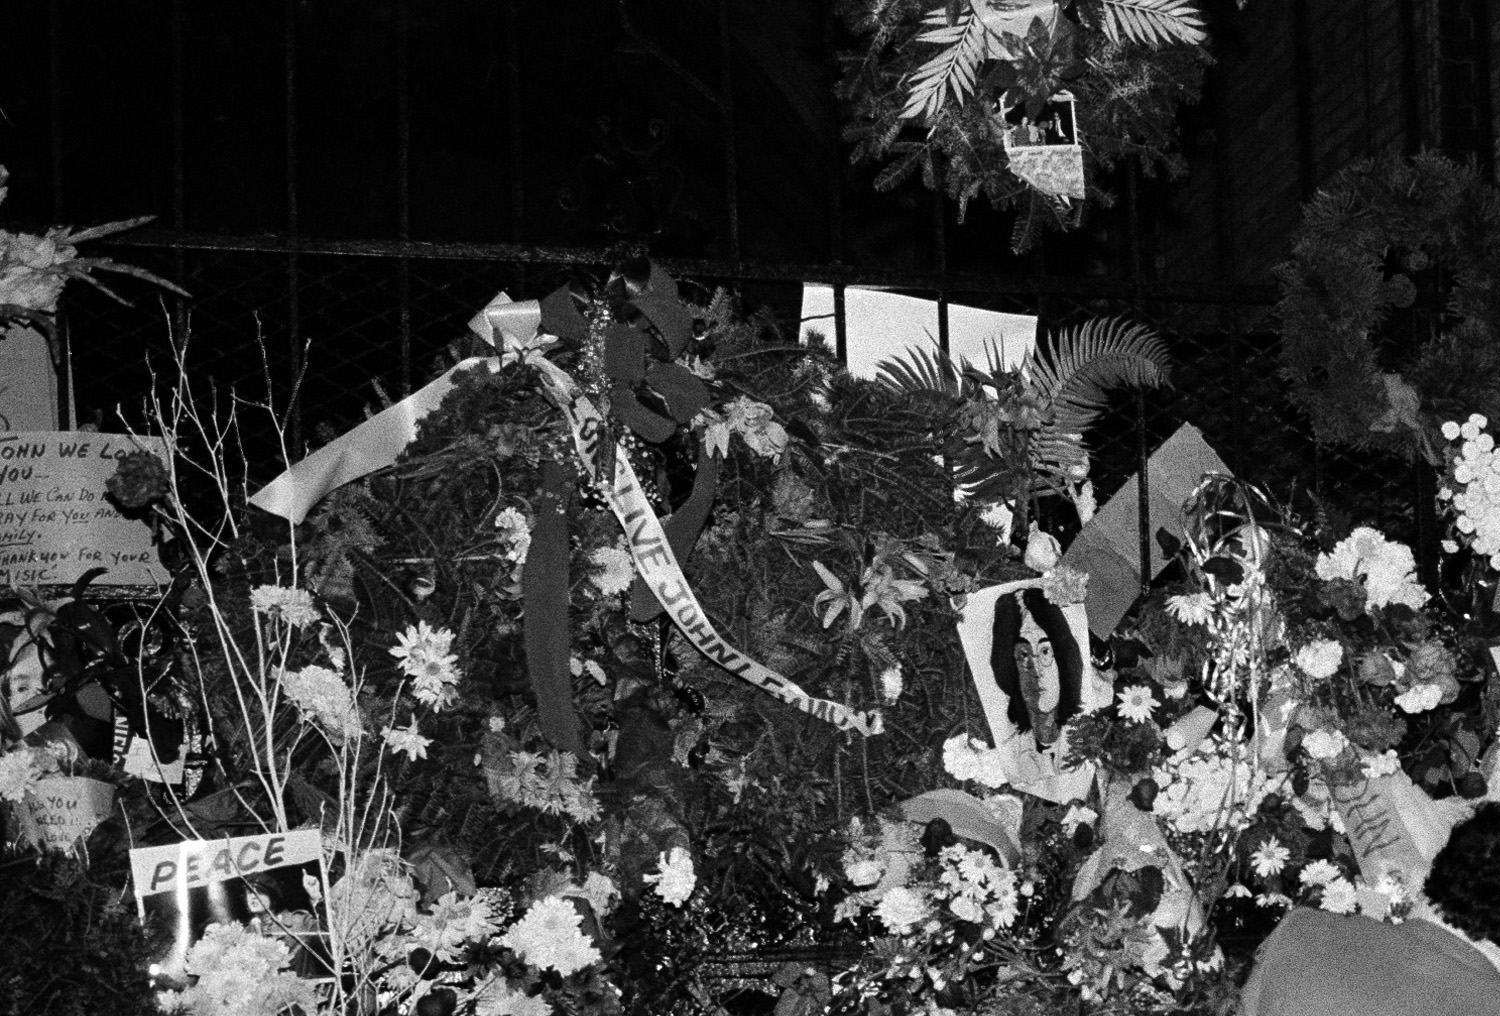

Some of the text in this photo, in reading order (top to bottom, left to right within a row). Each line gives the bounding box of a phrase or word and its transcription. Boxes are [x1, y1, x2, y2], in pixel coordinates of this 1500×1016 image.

[59, 442, 90, 458] WE
[31, 508, 56, 522] FOR
[62, 509, 90, 525] YOU
[78, 547, 101, 562] FOR
[111, 551, 150, 565] YOUR
[612, 485, 672, 574] LIVE
[658, 579, 740, 665] JOHN
[150, 837, 286, 891] PEACE
